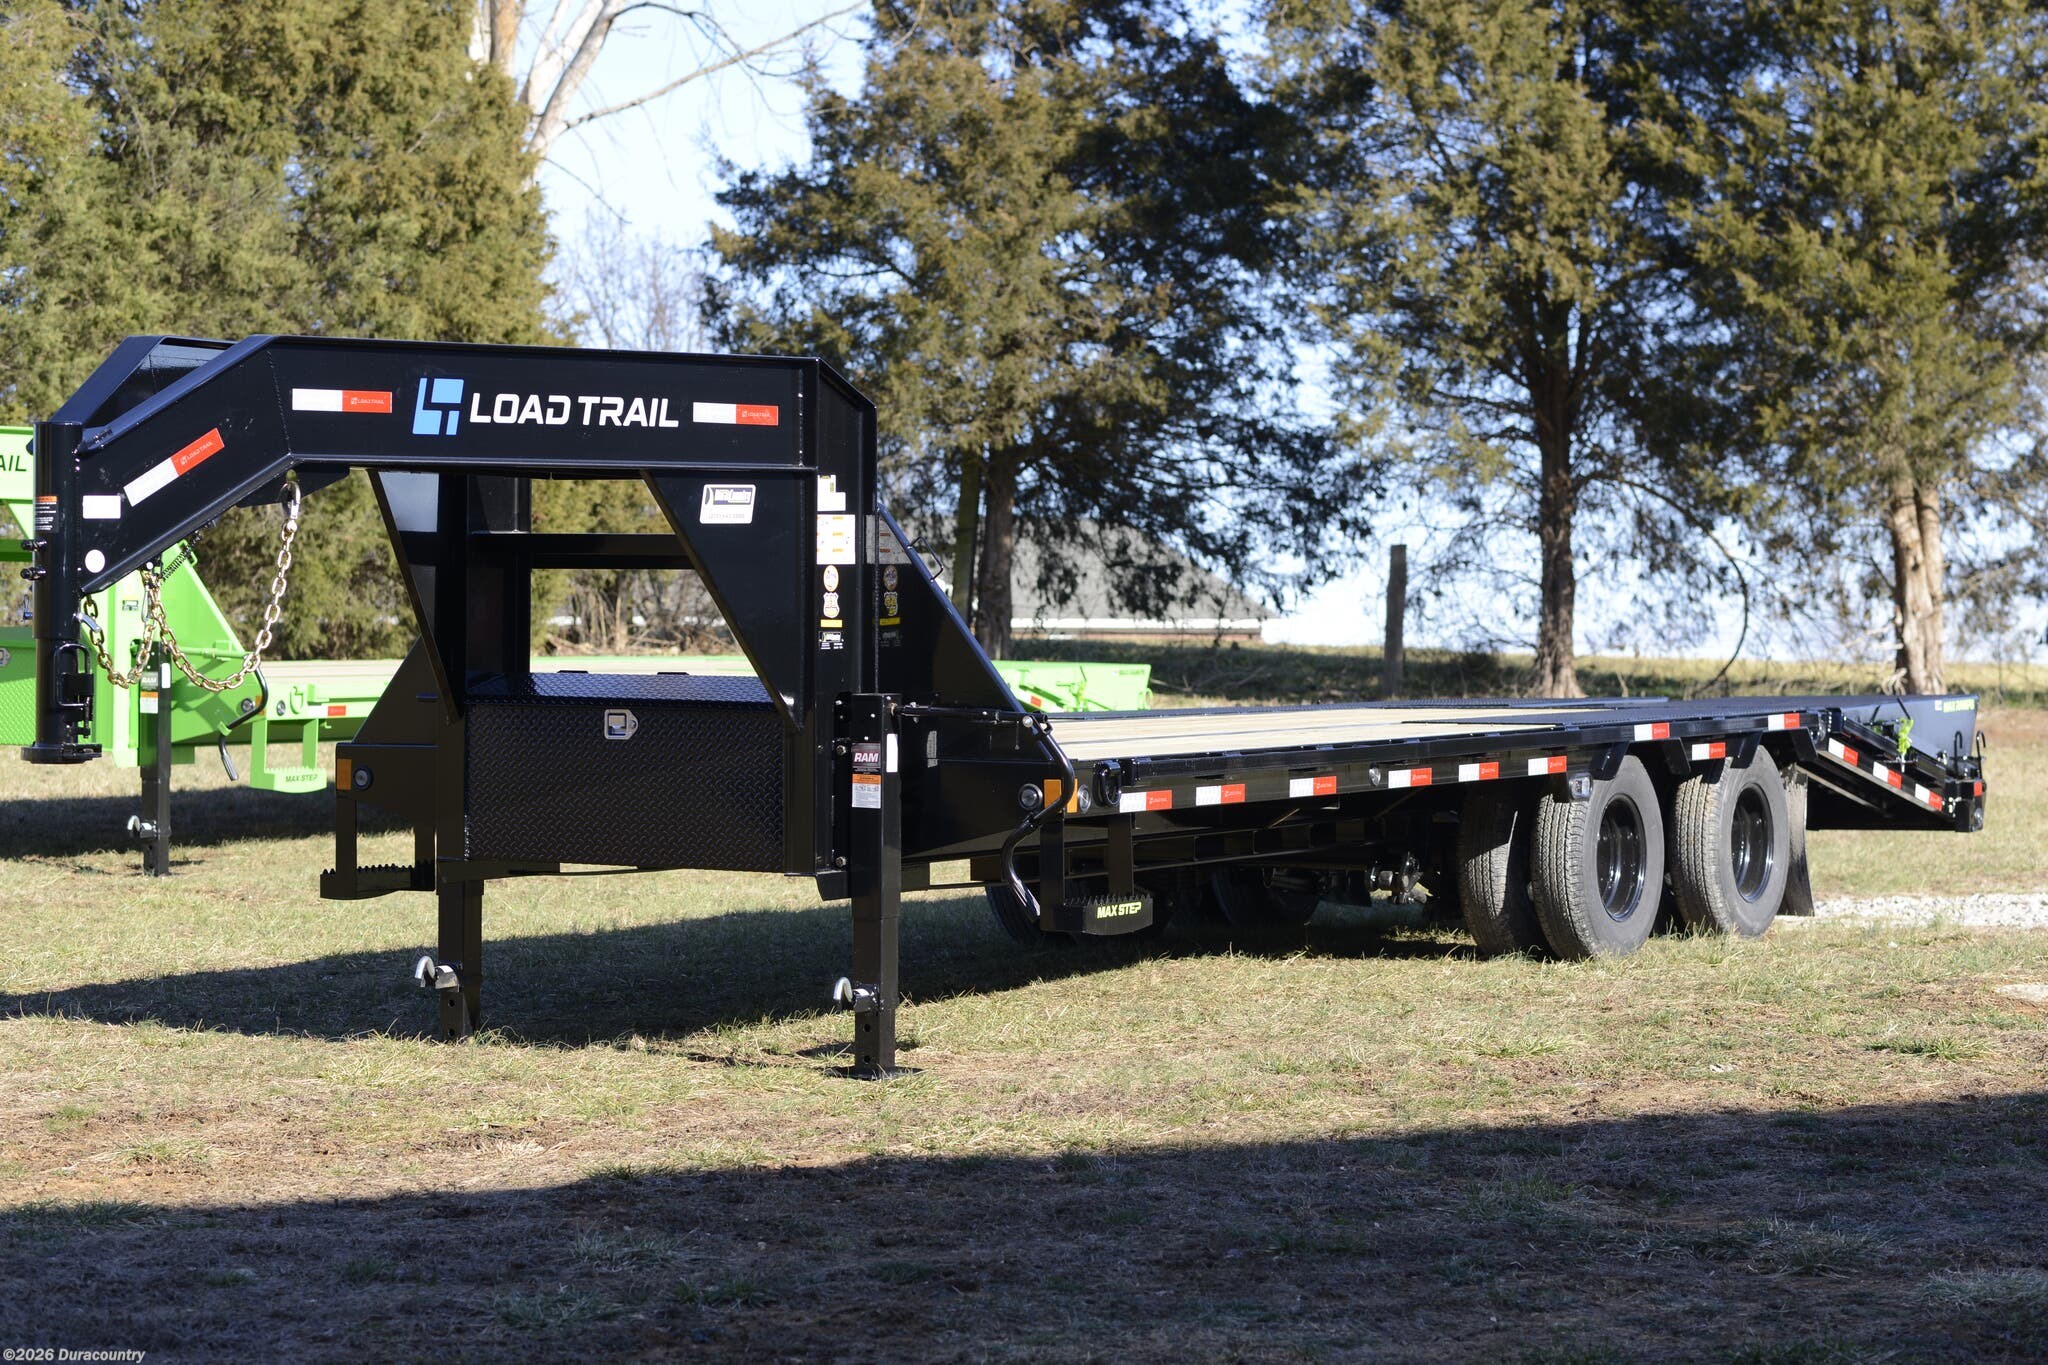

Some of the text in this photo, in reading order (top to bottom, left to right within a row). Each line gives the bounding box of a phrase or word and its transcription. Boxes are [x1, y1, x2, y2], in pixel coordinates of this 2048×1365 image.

[469, 392, 680, 428] LOAD TRAIL
[853, 752, 879, 763] RAM
[285, 775, 299, 783] MAX
[1096, 901, 1142, 919] MAX STEP
